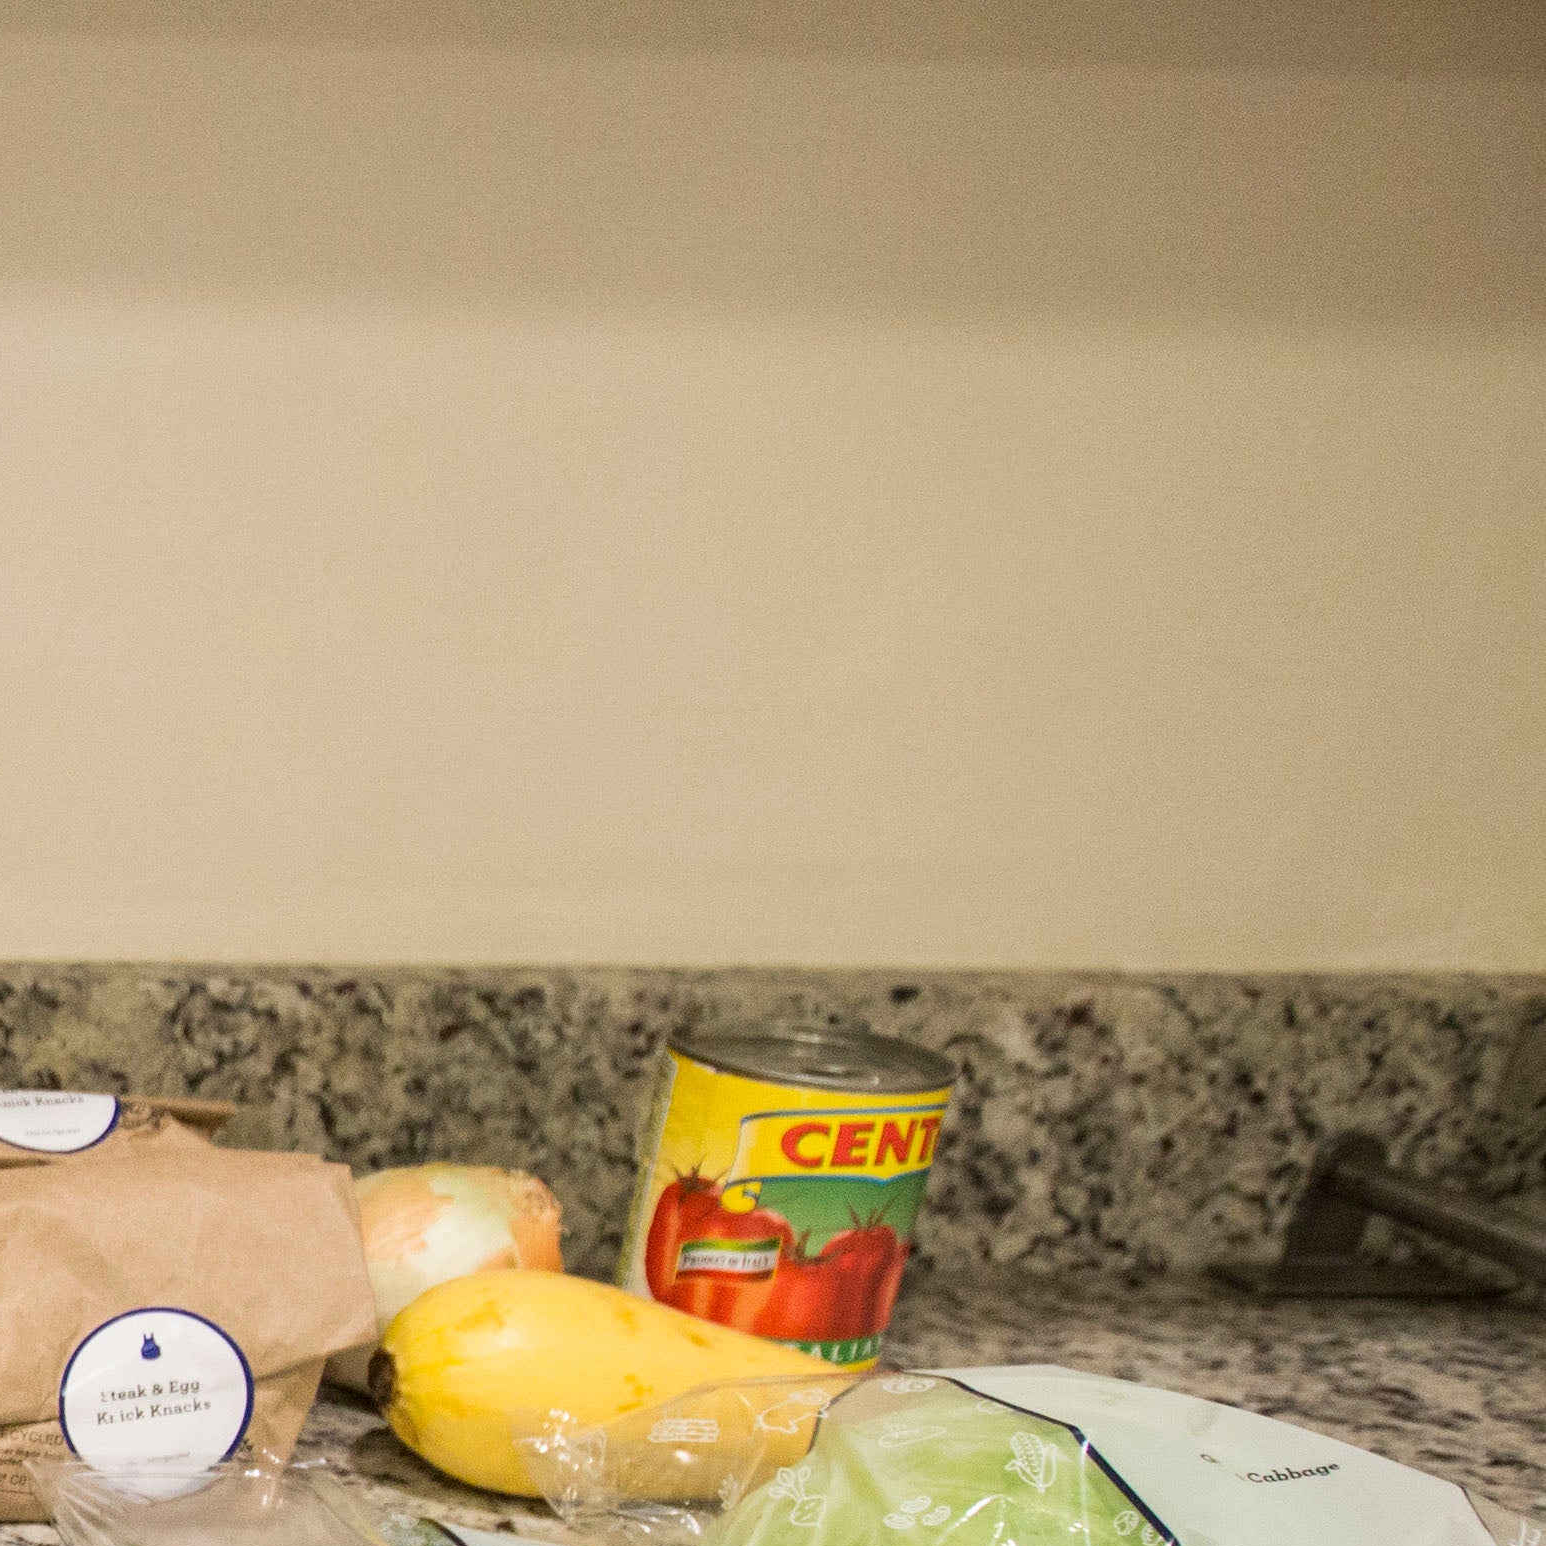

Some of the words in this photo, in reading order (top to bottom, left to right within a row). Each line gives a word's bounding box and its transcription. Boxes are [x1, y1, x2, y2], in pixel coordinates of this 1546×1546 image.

[152, 1383, 165, 1396] &
[169, 1379, 201, 1396] Egg
[150, 1399, 212, 1418] Knacks
[1246, 1460, 1342, 1486] Cabbage
